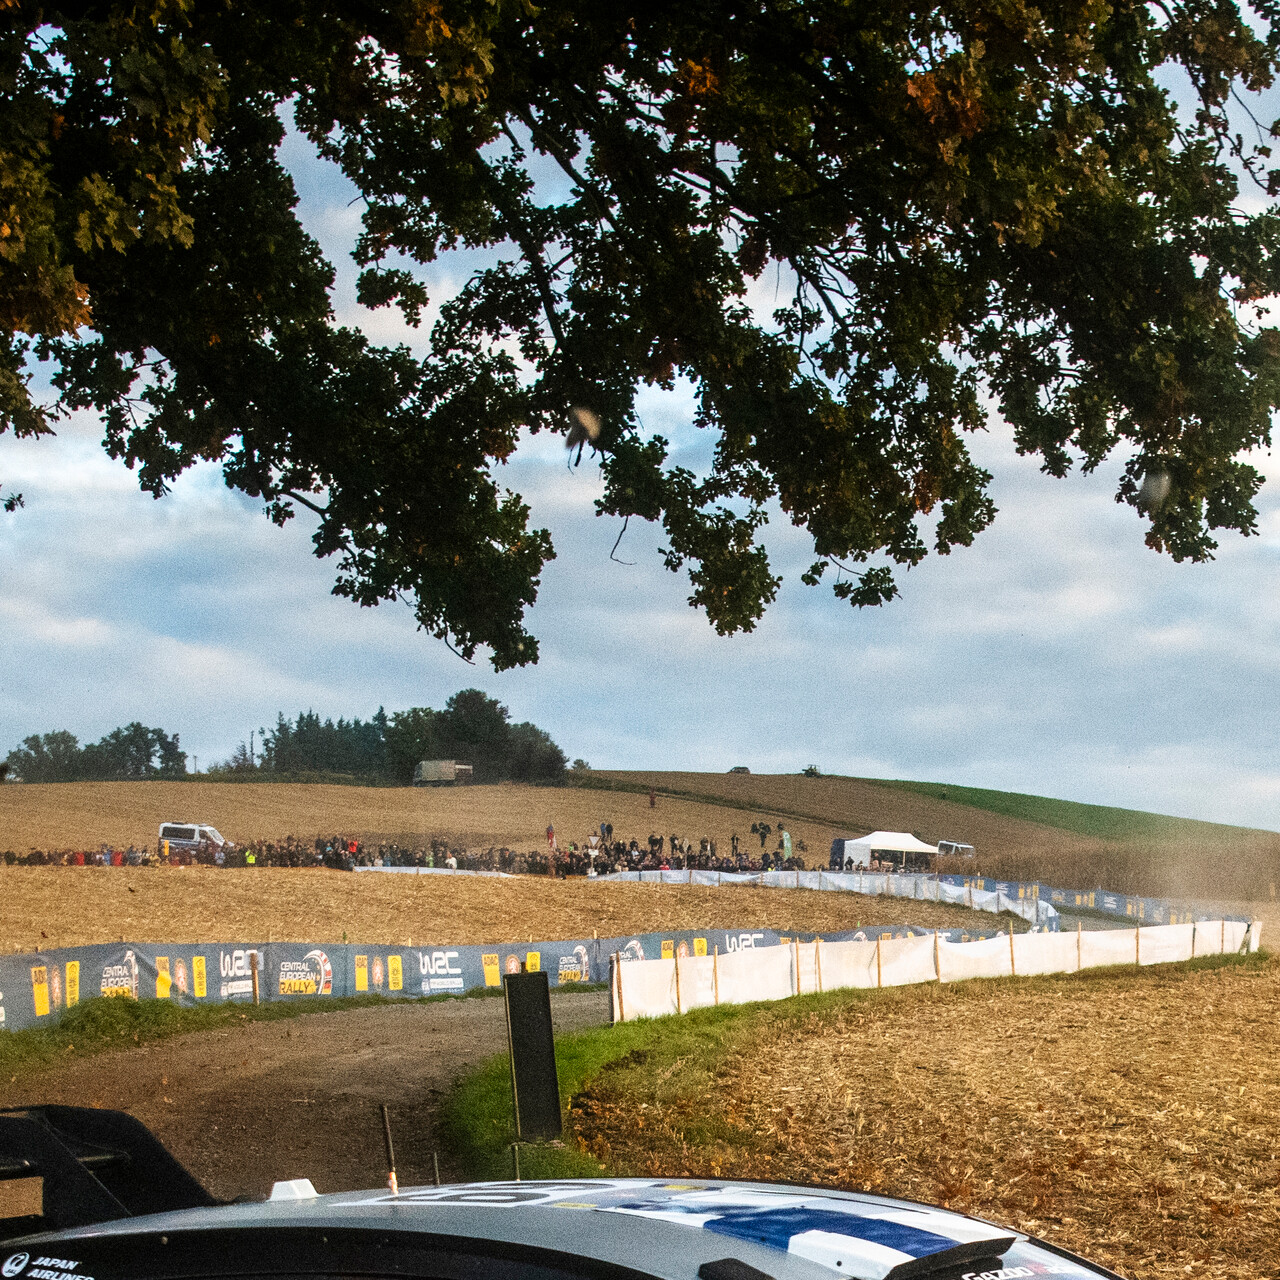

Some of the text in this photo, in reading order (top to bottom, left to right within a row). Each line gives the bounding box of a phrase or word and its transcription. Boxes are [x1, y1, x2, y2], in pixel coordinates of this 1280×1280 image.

[281, 961, 310, 971] CENTRAL
[419, 951, 461, 975] WRC
[280, 972, 316, 980] EUROPEAN
[280, 982, 311, 993] RALLY
[31, 1256, 79, 1269] JAPAN
